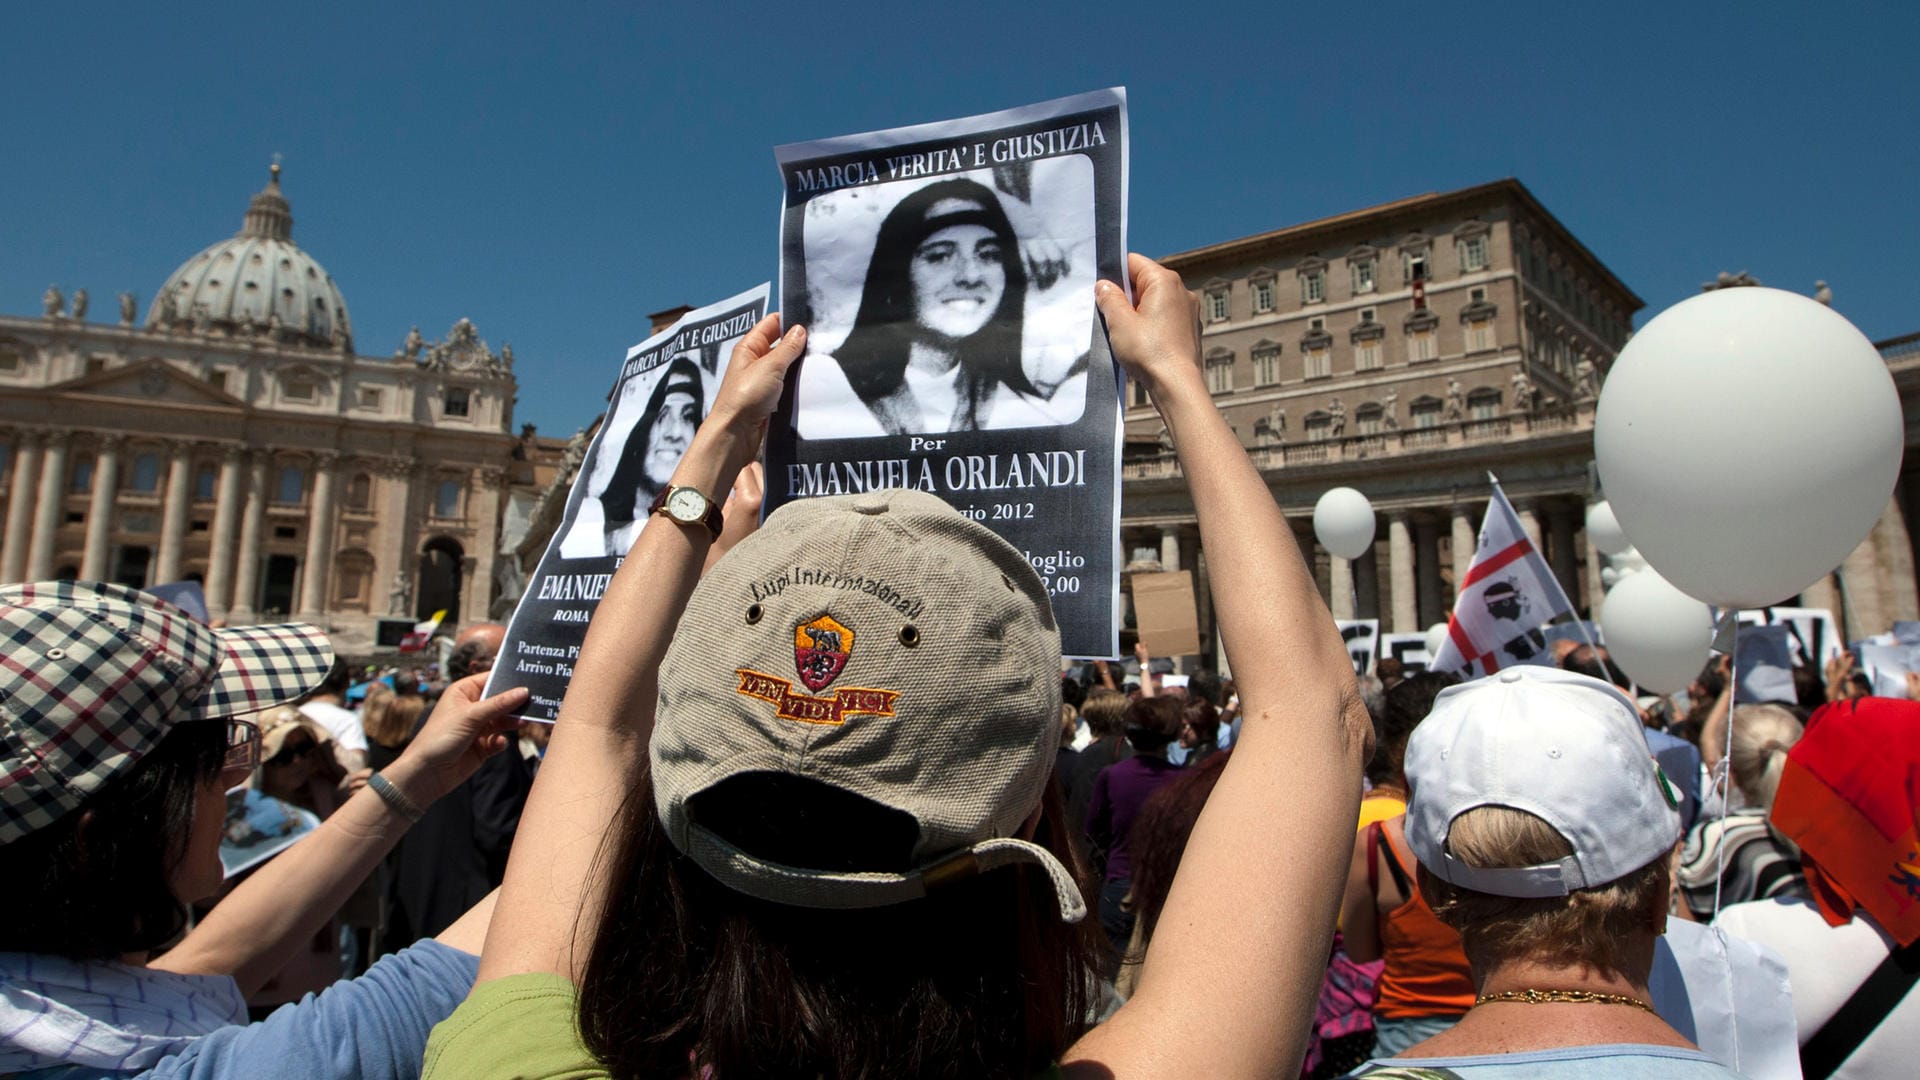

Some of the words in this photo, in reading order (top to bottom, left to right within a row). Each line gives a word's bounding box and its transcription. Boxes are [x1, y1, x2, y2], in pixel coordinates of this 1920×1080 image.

[796, 160, 880, 193] MARCIA
[974, 143, 987, 167] E
[992, 121, 1107, 163] GIUSTIZIA
[623, 351, 658, 379] MARCIA
[691, 328, 701, 348] E
[702, 309, 757, 345] GIUSTIZIA
[910, 437, 946, 451] Per
[787, 458, 937, 497] EMANUELA
[945, 450, 1087, 491] ORLANDI
[992, 503, 1034, 520] 2012
[750, 570, 791, 602] Lupi
[795, 567, 926, 620] Internazionali
[553, 609, 590, 622] ROMA
[517, 641, 565, 658] Partenza
[516, 659, 553, 675] Arrivo
[746, 676, 786, 702] VENI
[785, 698, 834, 721] VIDI
[837, 690, 885, 710] VICI
